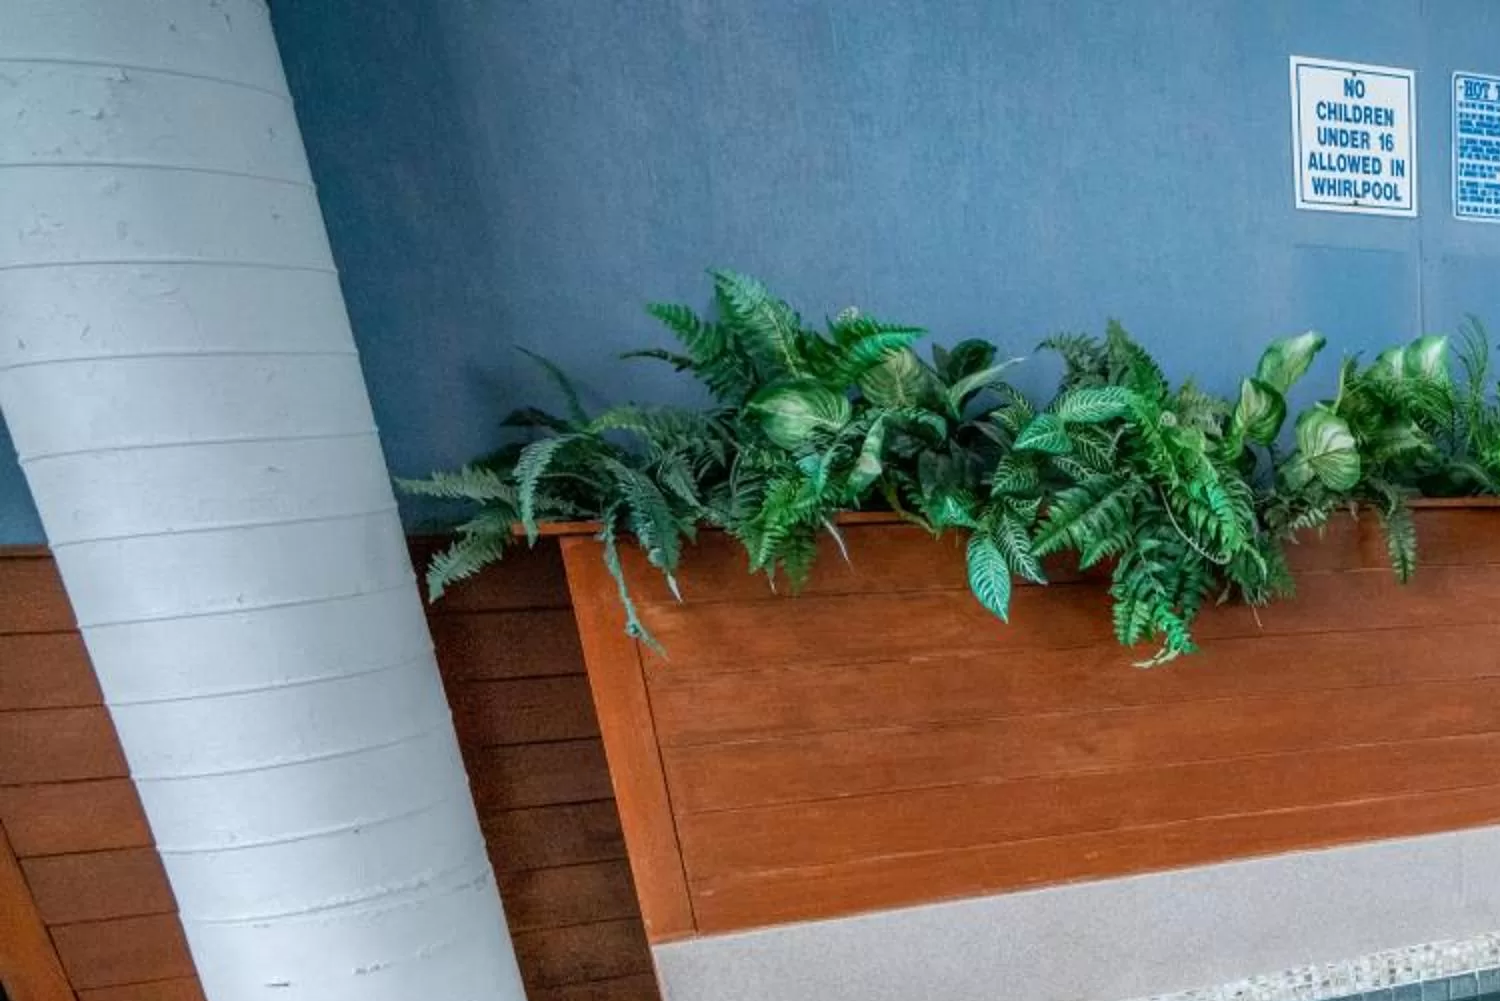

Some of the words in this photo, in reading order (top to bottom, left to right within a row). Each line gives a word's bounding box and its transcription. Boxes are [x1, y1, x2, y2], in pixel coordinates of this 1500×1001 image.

[1343, 78, 1366, 98] NO
[1463, 80, 1491, 101] HOT
[1316, 101, 1395, 128] CHILDREN
[1317, 126, 1371, 151] UNDER
[1378, 132, 1395, 152] 16
[1307, 151, 1382, 175] ALLOWED
[1390, 159, 1406, 178] IN
[1311, 176, 1403, 201] WHIRLPOOL
